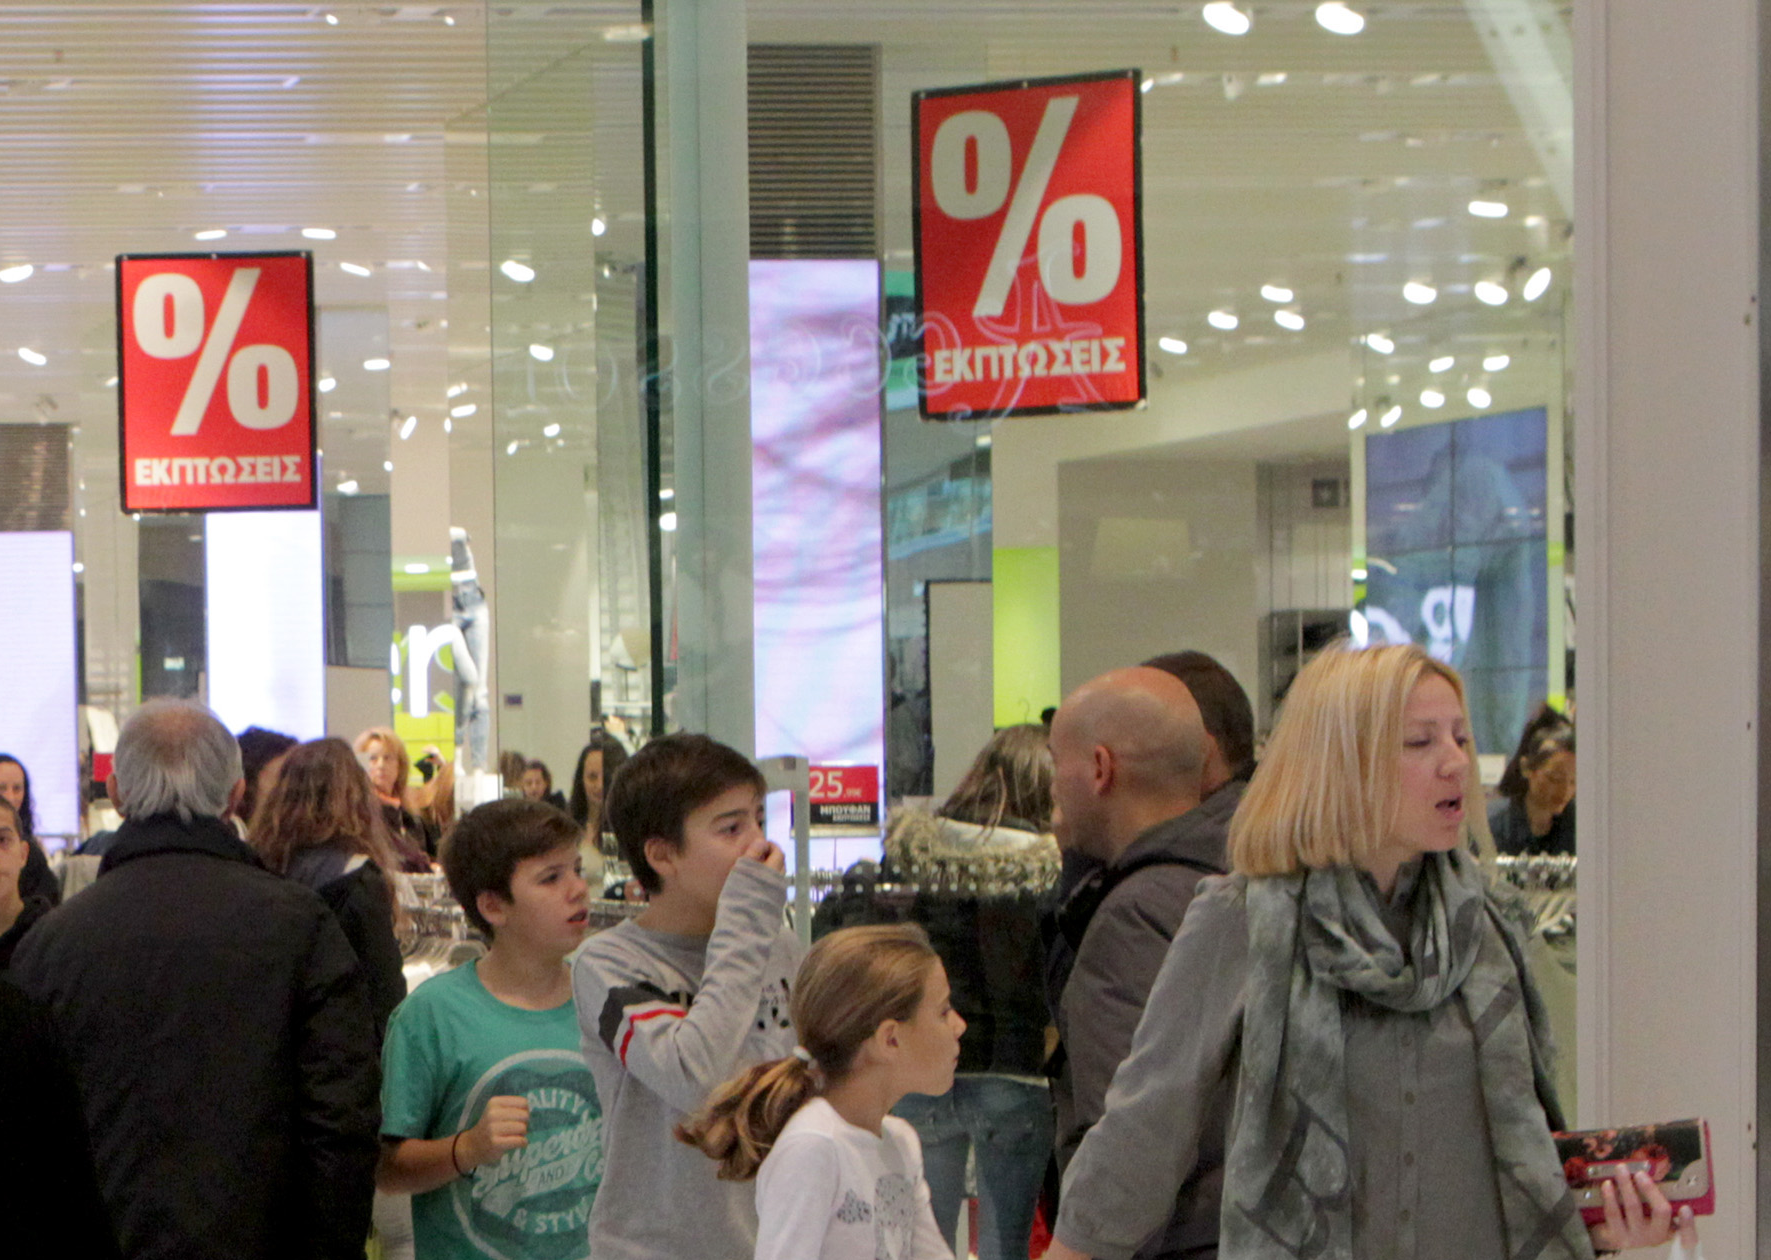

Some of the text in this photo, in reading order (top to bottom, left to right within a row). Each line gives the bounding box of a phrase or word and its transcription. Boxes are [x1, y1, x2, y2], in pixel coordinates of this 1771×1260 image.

[933, 336, 1127, 384] ΕΚΠΤΩΣΕΙΣ
[133, 454, 302, 487] ΕΚΠΤΩΣΕΙΣ
[526, 1086, 586, 1113] ALITY
